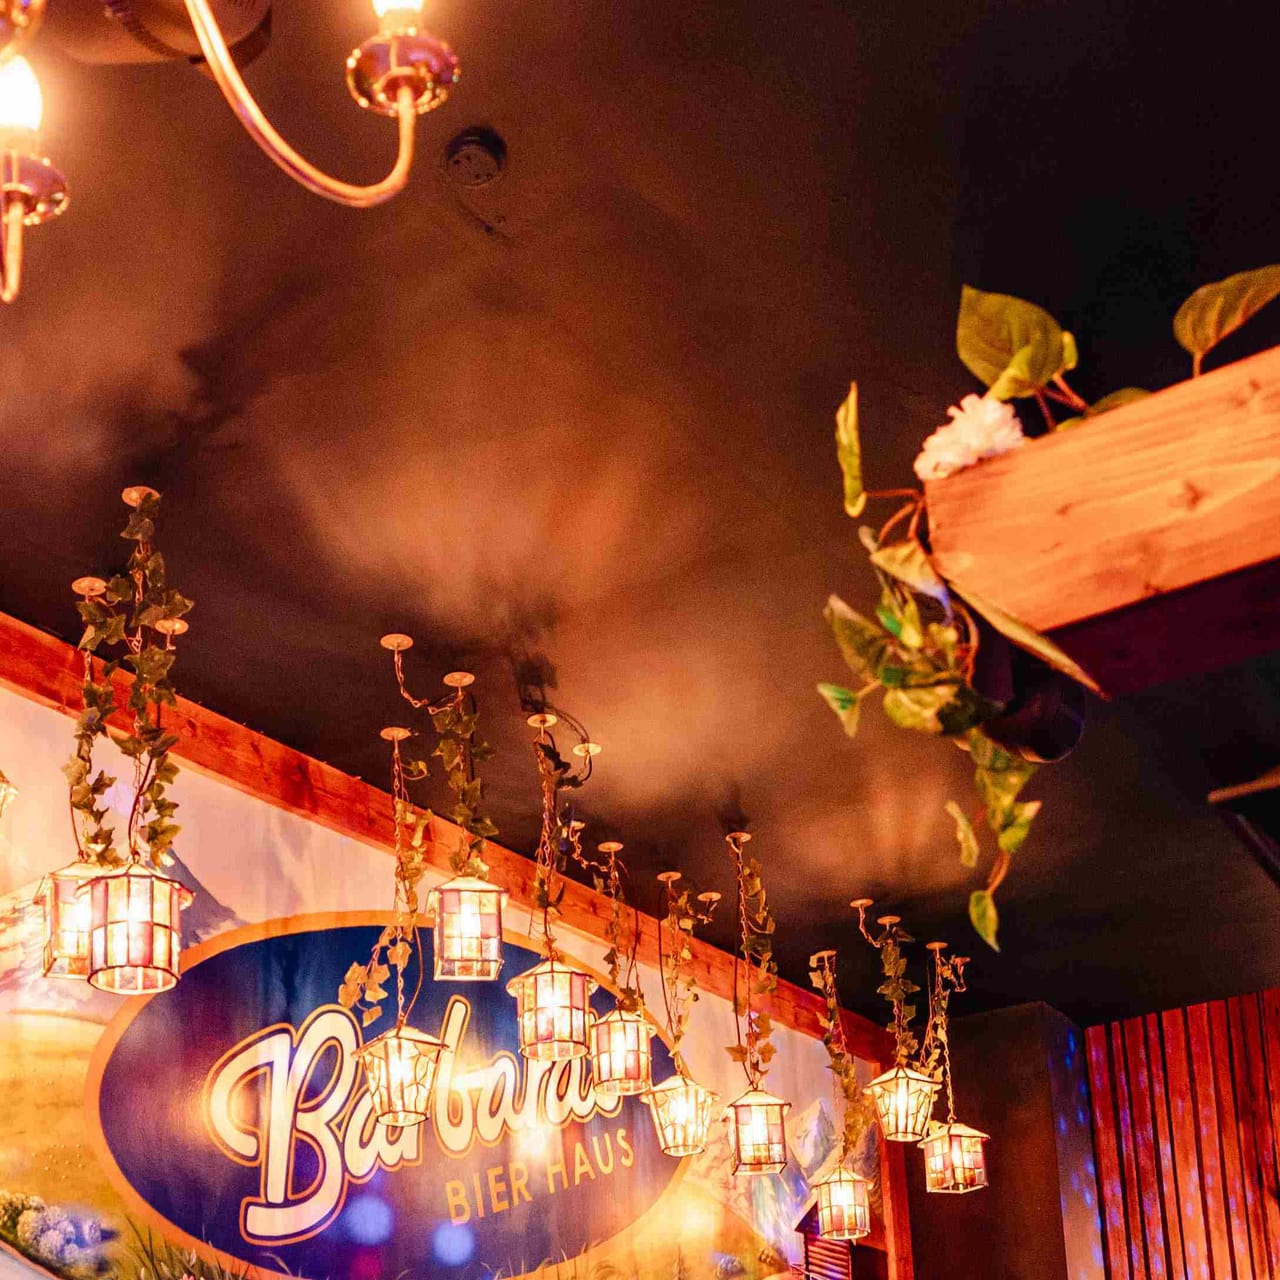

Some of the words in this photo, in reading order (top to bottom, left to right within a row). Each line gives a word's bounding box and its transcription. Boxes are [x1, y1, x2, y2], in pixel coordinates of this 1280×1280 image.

[204, 994, 623, 1246] Barbara
[445, 1162, 529, 1226] BIER
[546, 1128, 635, 1192] HAUS
